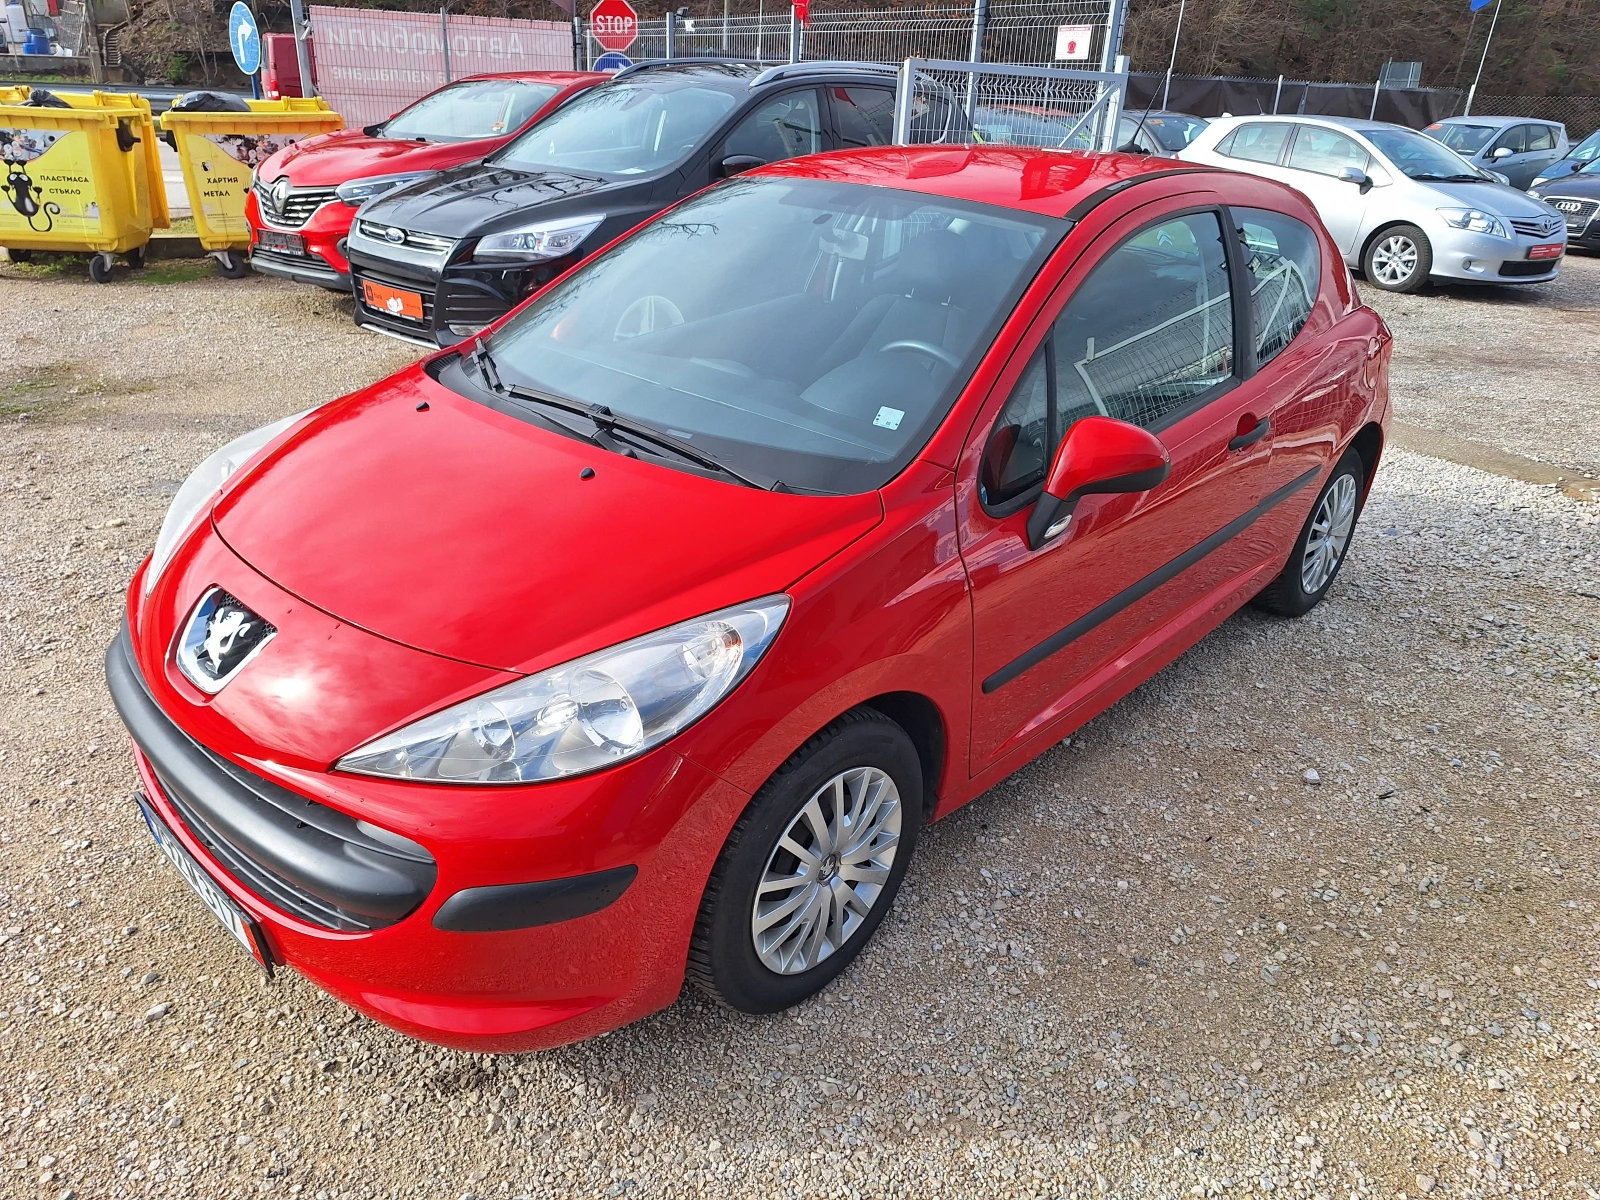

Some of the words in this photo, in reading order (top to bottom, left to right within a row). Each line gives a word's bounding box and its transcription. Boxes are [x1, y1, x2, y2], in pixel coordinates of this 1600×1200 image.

[596, 15, 633, 35] STOP
[40, 174, 90, 183] ПЛАСТМАСА
[206, 176, 239, 184] ХАРТИЯ
